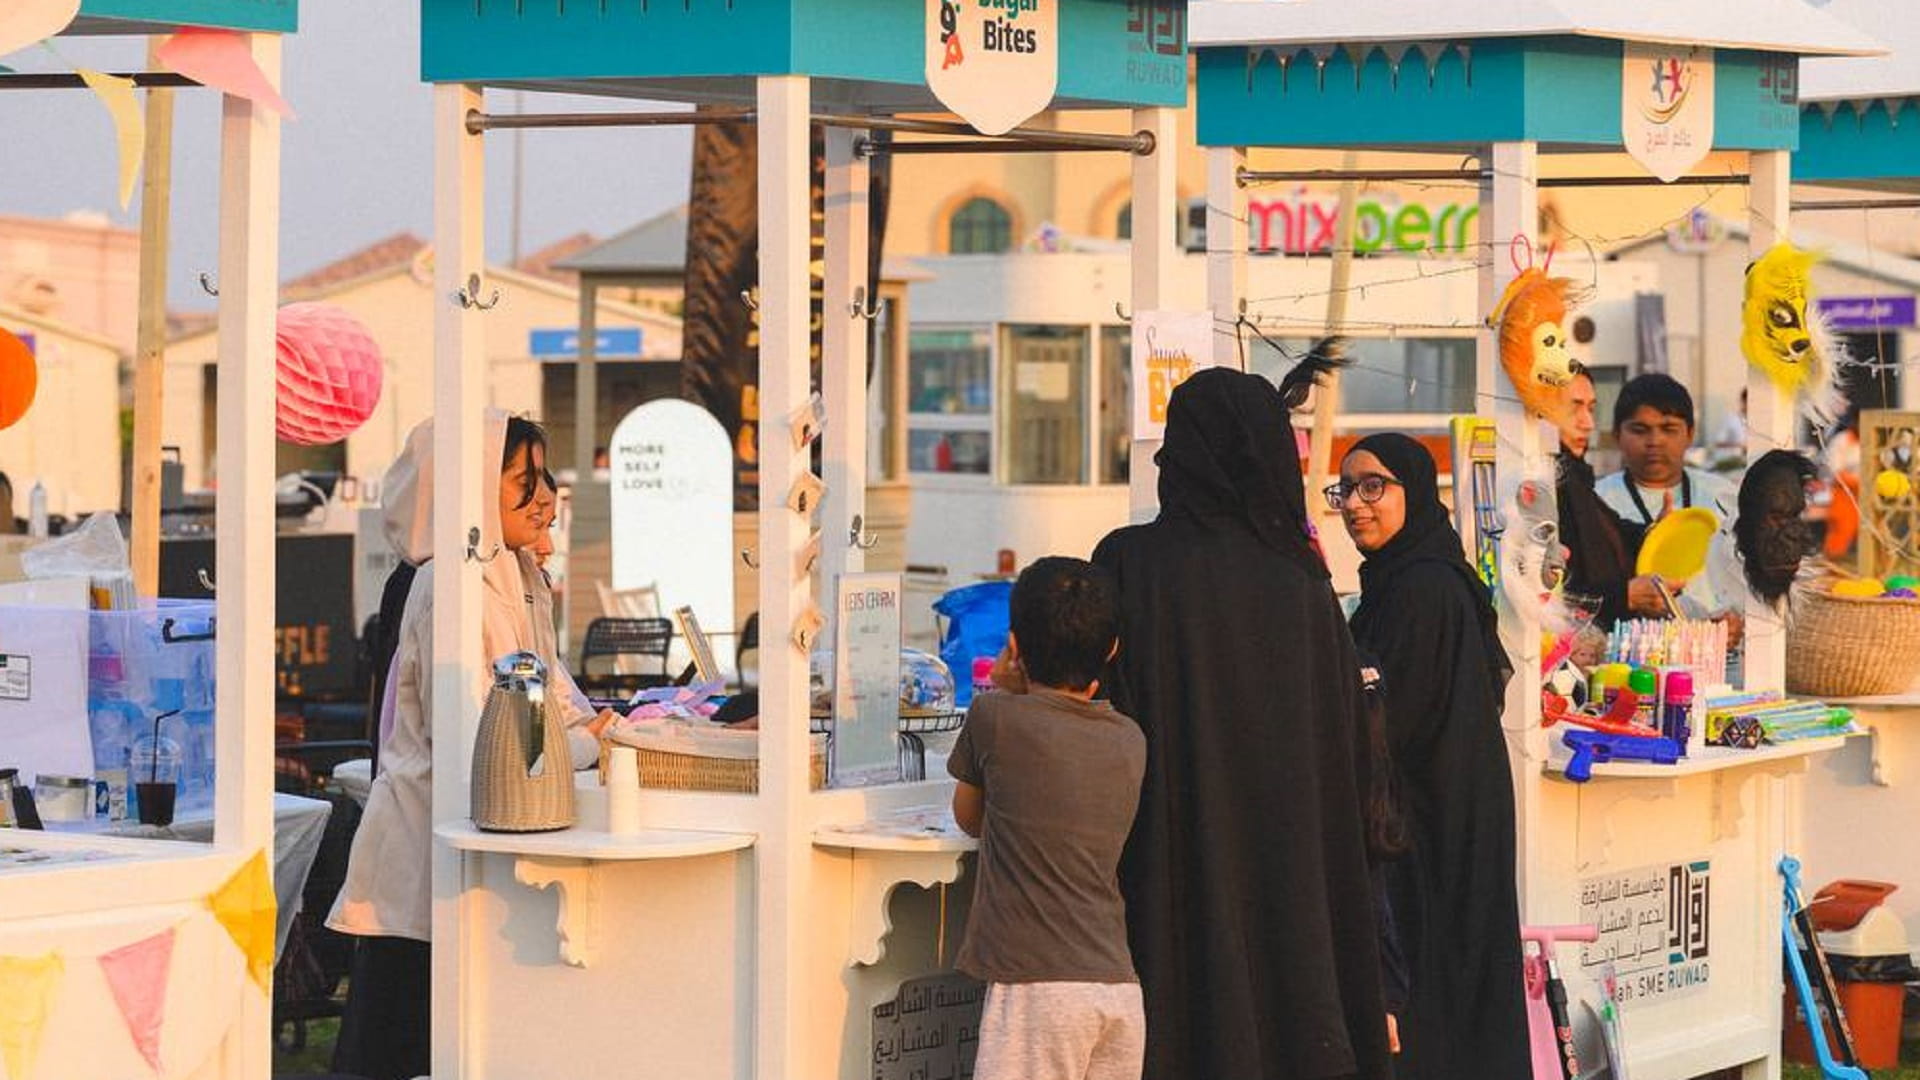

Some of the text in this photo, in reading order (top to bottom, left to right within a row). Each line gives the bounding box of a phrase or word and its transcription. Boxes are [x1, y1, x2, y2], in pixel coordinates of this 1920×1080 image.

[983, 16, 1037, 54] Bites
[1126, 61, 1183, 87] RUWAD
[1580, 868, 1664, 910] مؤسسة الشارقة
[1638, 971, 1665, 997] SME
[1667, 962, 1710, 989] RUWAD
[873, 1020, 951, 1064] المشاريع
